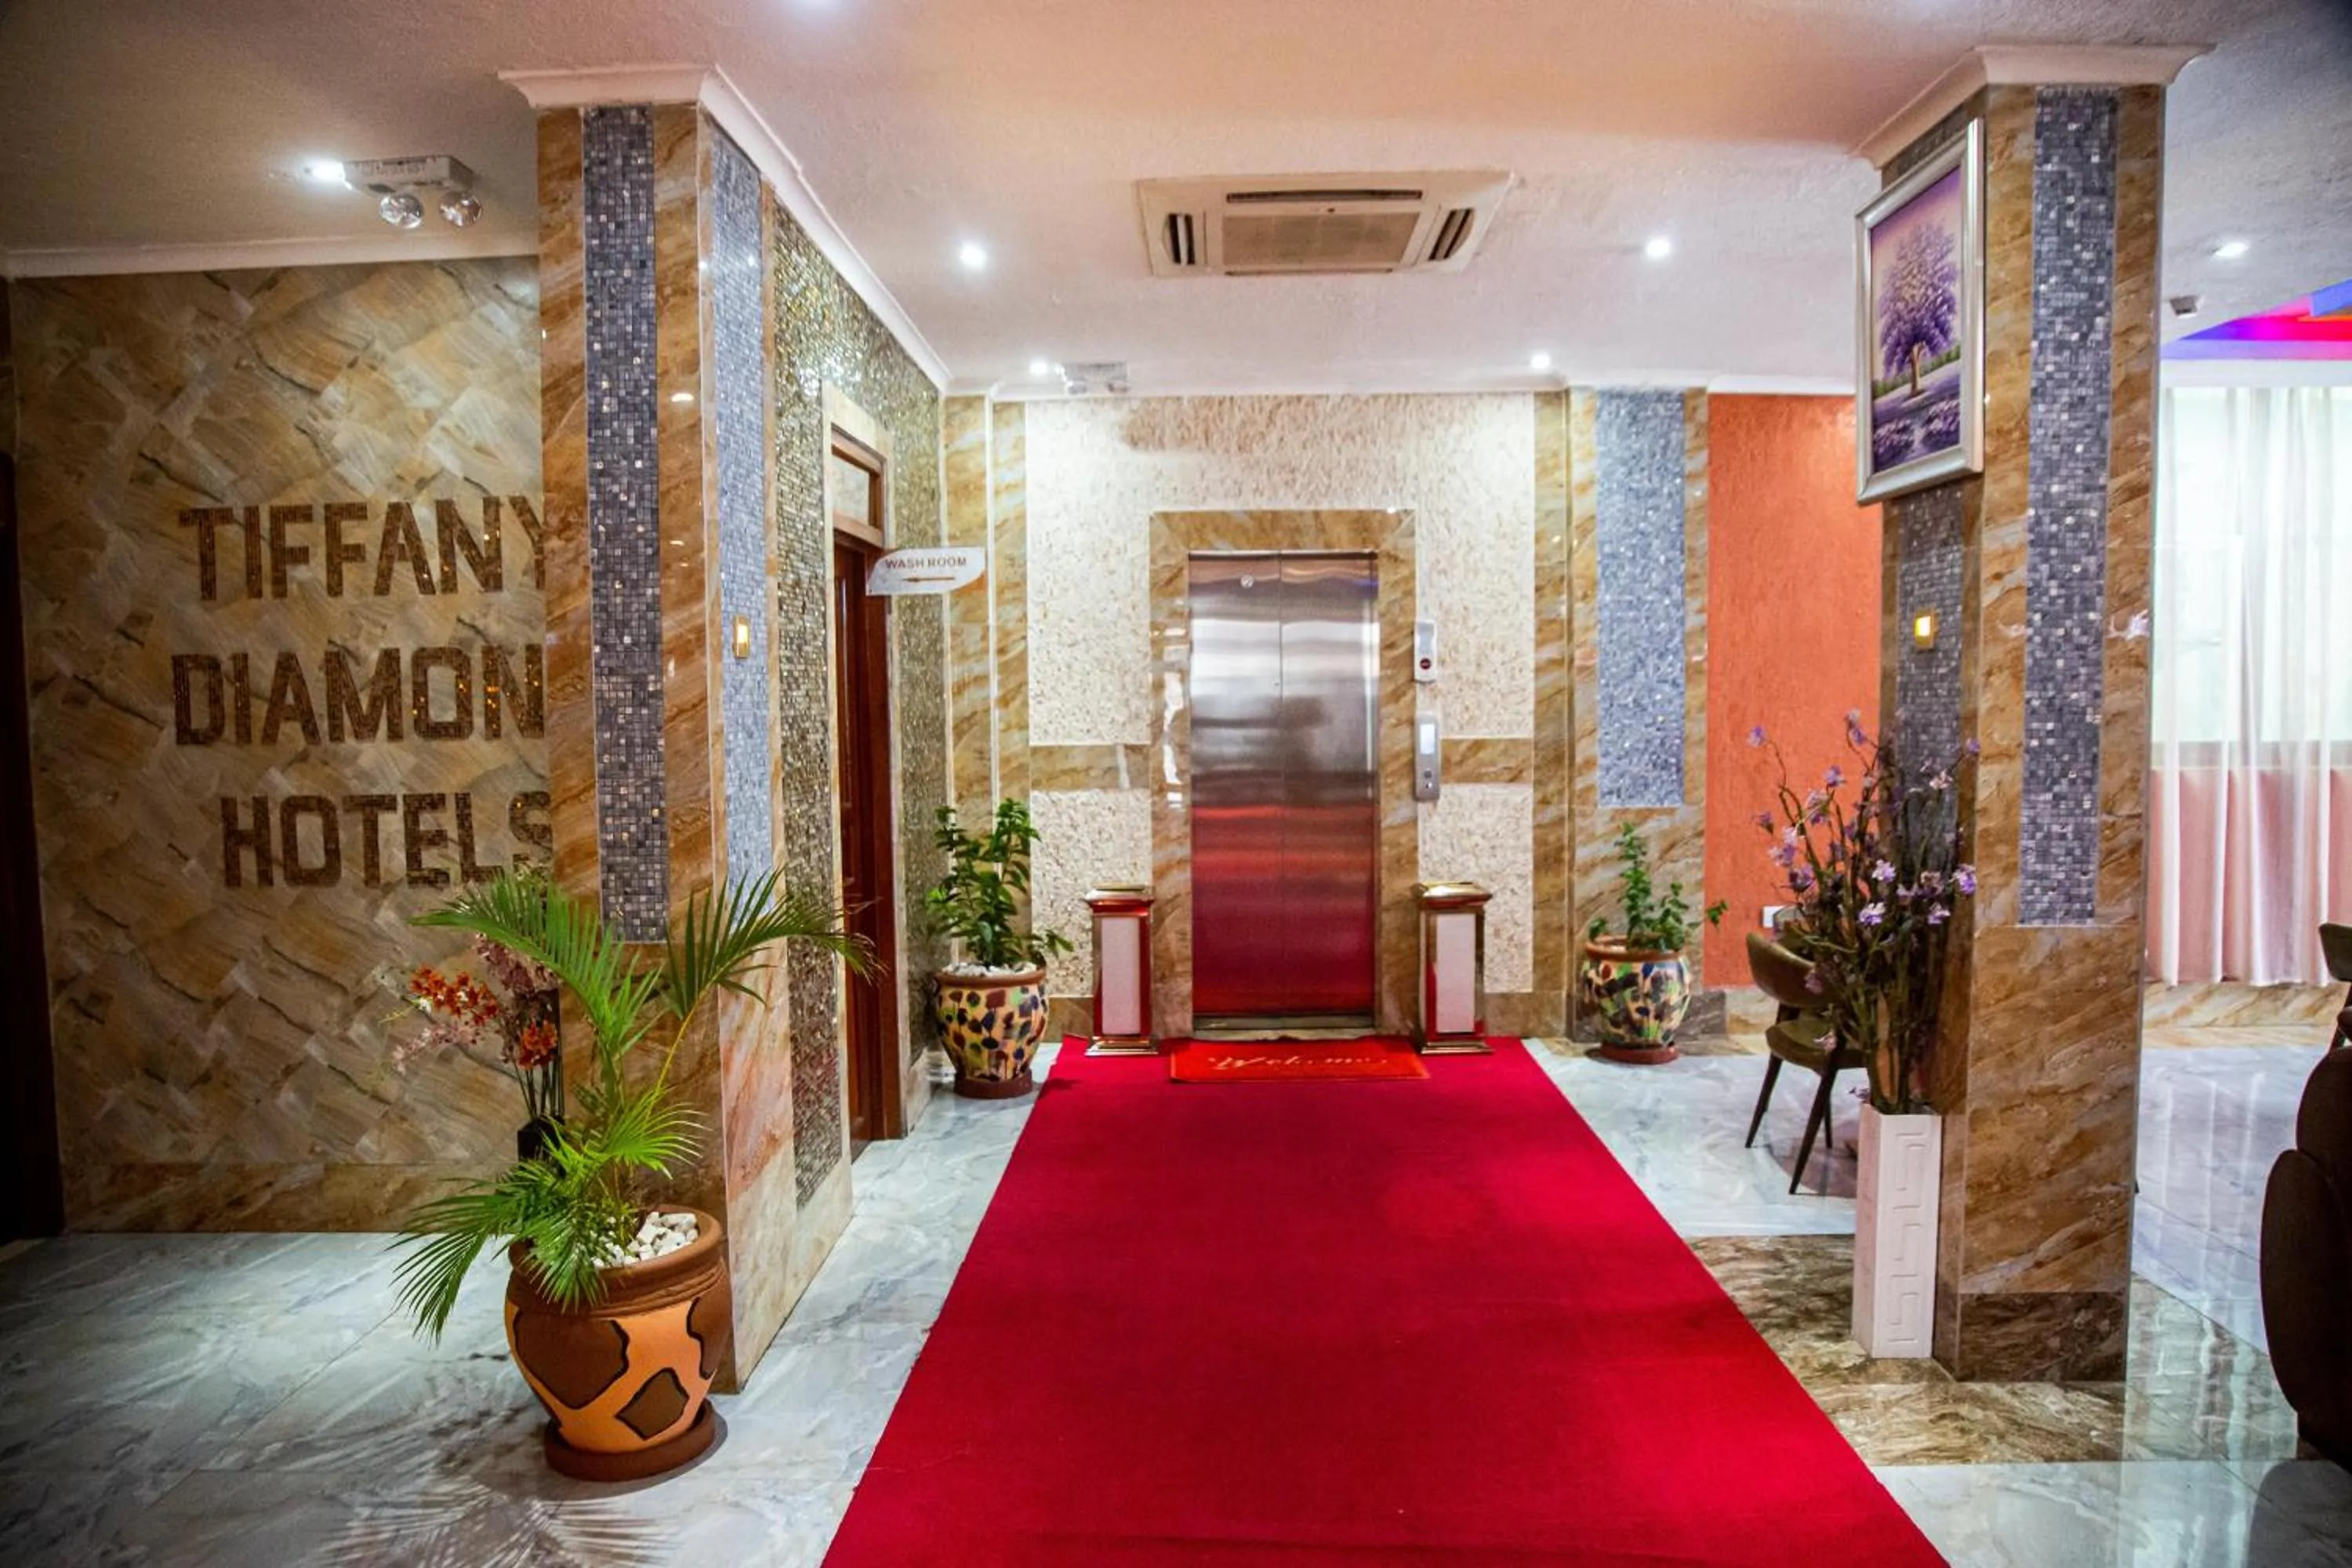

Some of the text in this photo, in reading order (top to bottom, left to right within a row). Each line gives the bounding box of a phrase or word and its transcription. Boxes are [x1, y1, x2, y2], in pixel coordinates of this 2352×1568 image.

[178, 496, 546, 601] TIFFANY
[885, 556, 967, 569] WASH ROOM
[171, 644, 546, 746] DIAMON
[220, 792, 553, 889] HOTELS
